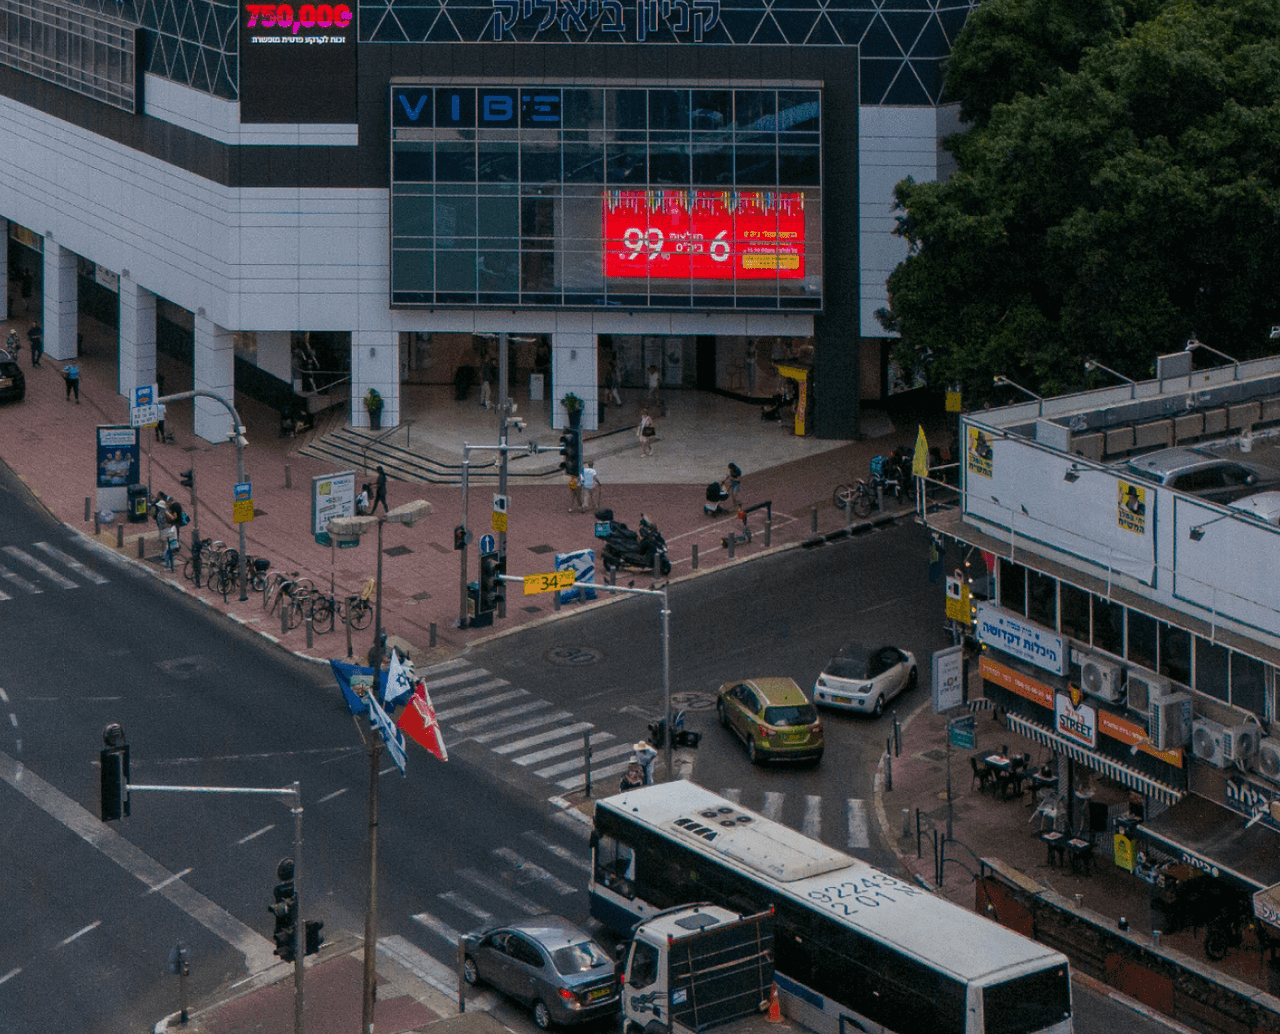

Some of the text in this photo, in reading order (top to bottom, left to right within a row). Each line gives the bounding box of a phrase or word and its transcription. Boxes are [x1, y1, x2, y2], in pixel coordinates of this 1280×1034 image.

[636, 0, 720, 42] קניון
[399, 94, 560, 121] VIBE
[540, 574, 560, 591] 34
[982, 621, 1021, 646] דקדושה
[1023, 638, 1057, 662] היכלות
[1059, 714, 1093, 738] STREET
[808, 874, 898, 903] 92243
